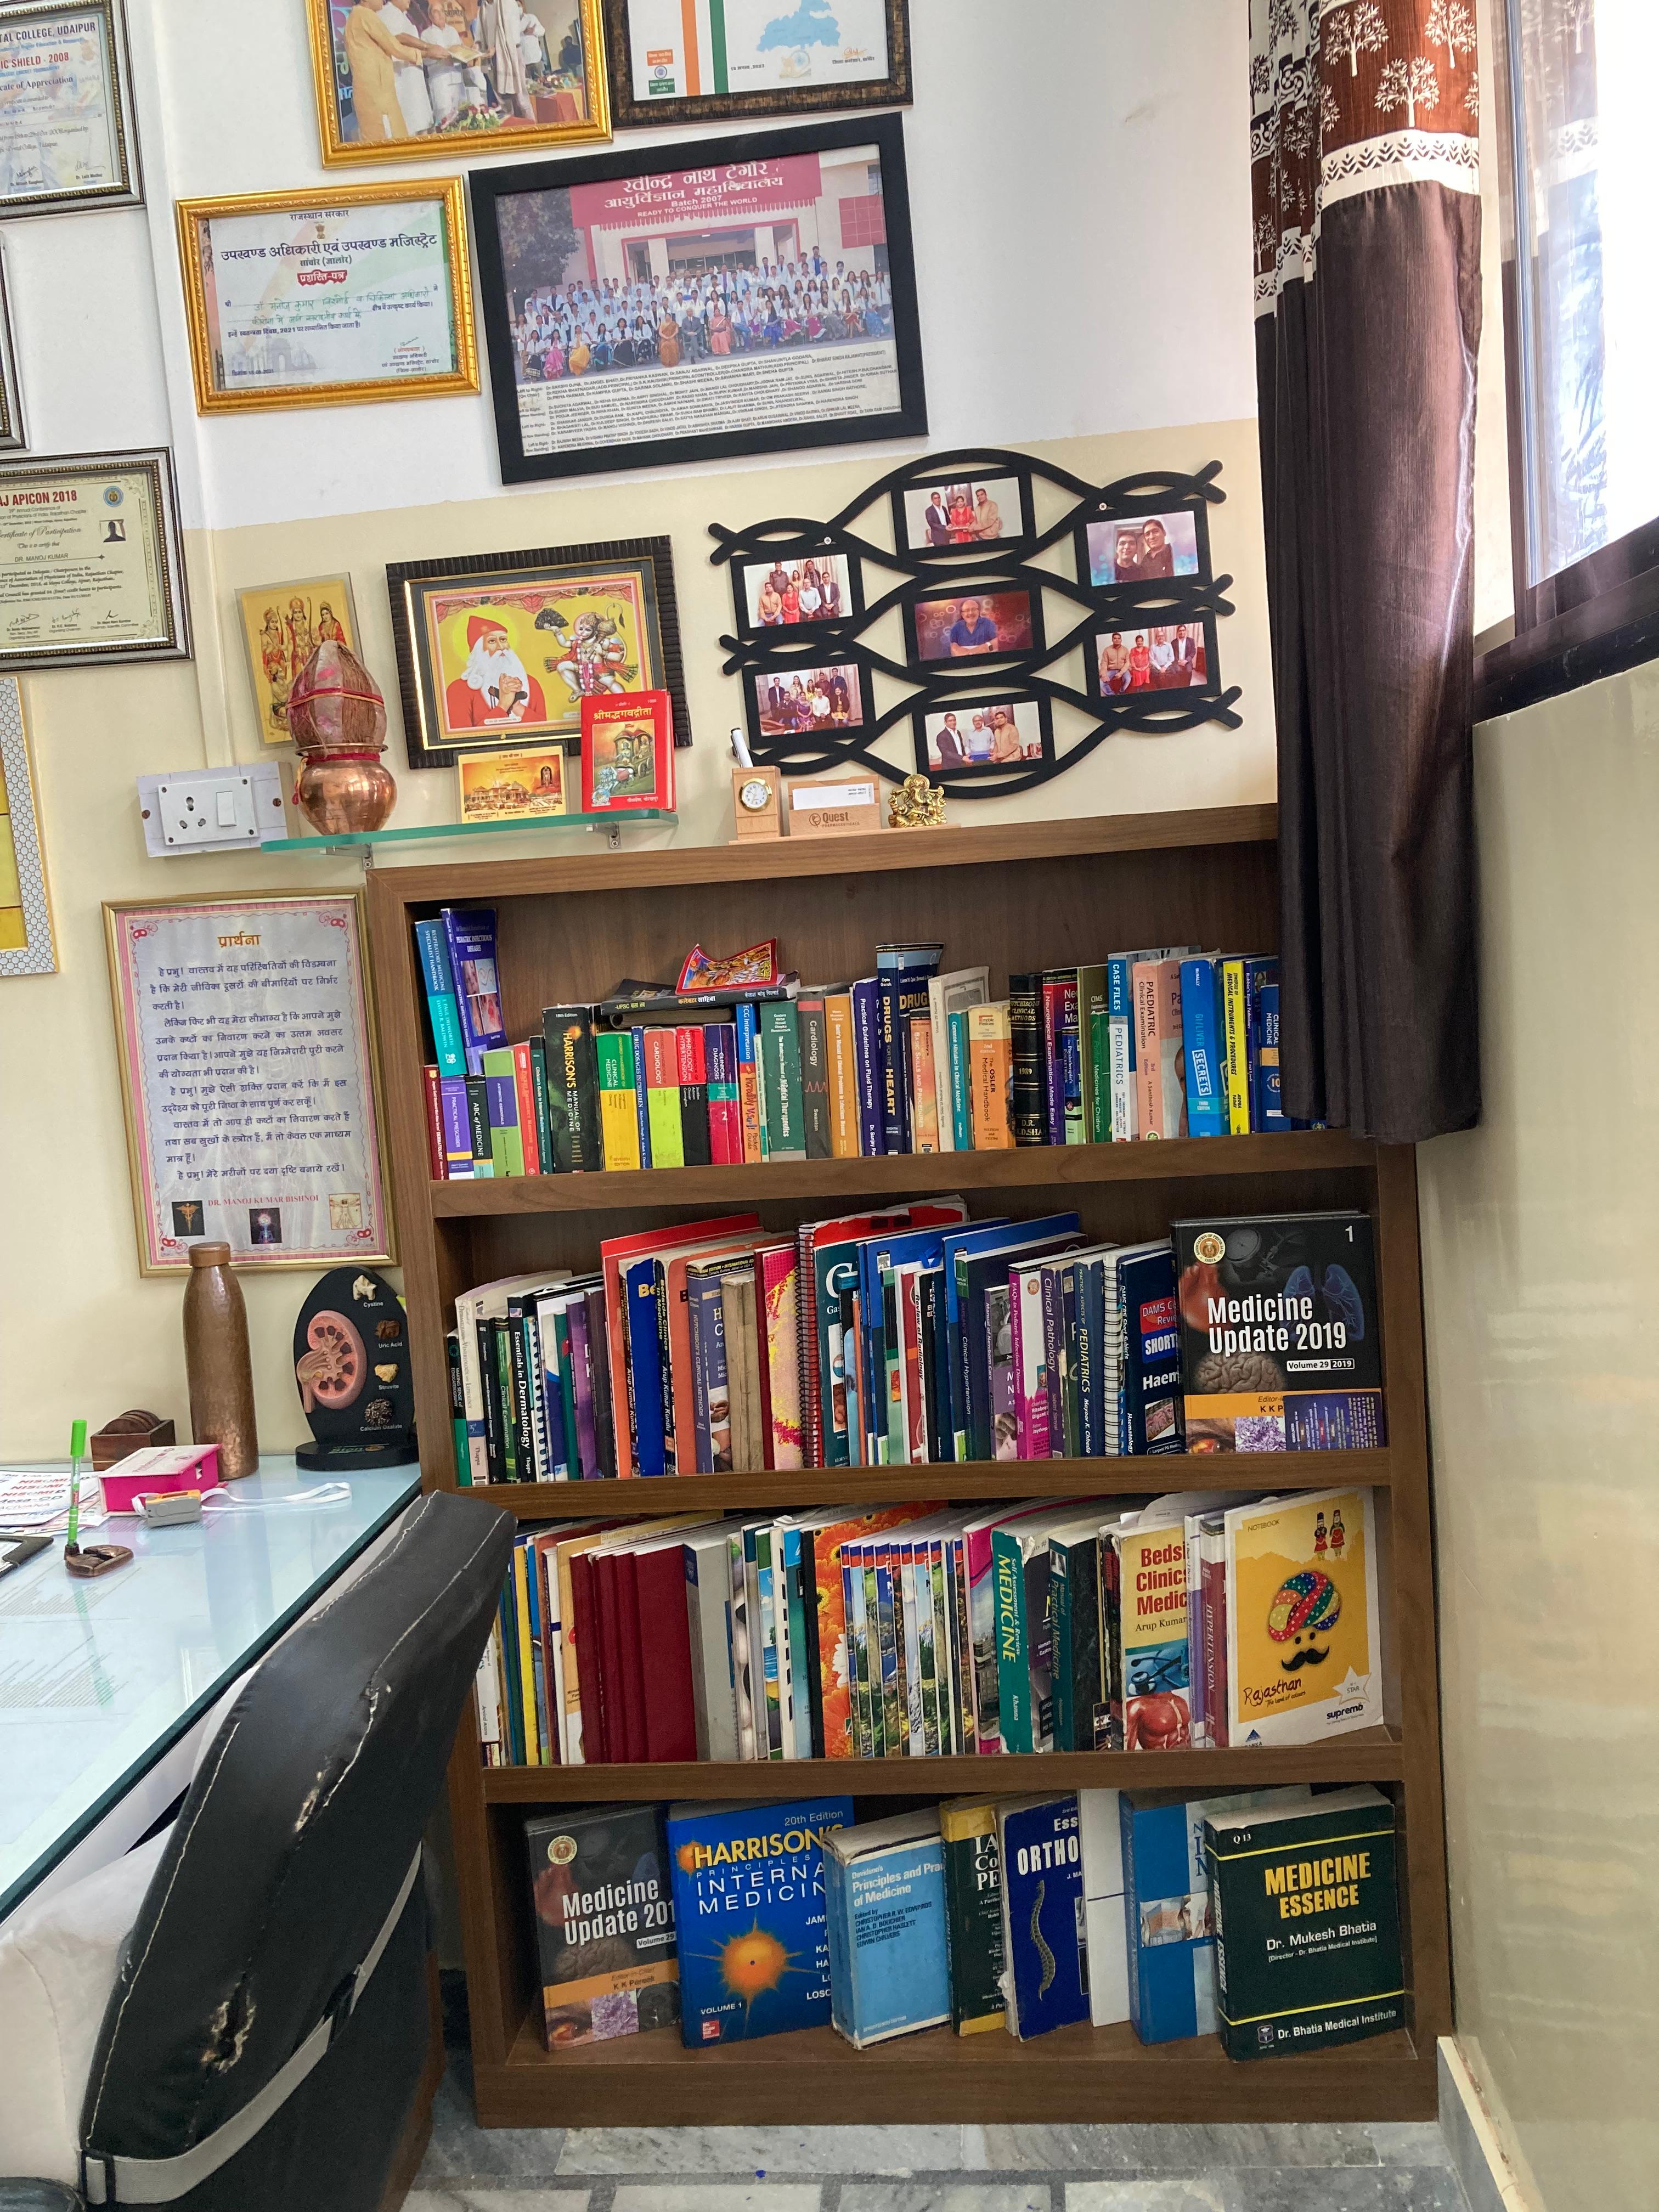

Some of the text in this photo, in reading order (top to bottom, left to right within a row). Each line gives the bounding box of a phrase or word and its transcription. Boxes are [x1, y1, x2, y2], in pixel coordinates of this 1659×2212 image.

[16, 22, 96, 41] COLLEGE, UDAIPUR
[12, 52, 69, 68] SHIELD 2008
[26, 76, 73, 89] Appreciation
[683, 168, 716, 184] नाथ
[671, 195, 722, 207] Batch 2007
[676, 203, 712, 213] CONQUER
[730, 197, 758, 205] WORLD
[289, 210, 349, 222] राजस्थान सरकार
[221, 246, 266, 261] उपखण्ड
[270, 241, 320, 257] अधिकारी
[323, 238, 339, 255] एवं
[341, 238, 387, 252] उपखण्ड
[13, 490, 77, 505] APICON 2018
[823, 811, 849, 822] Quest
[217, 932, 261, 948] प्रार्थना
[431, 930, 441, 963] RESPIRATORY
[189, 965, 214, 974] वास्तव
[227, 964, 238, 972] यह
[289, 960, 299, 968] की
[425, 930, 439, 991] SPECIALIST HANDBOOK
[1146, 981, 1155, 1037] PAEDIATRIC
[810, 1020, 818, 1066] Cardiology
[1195, 1013, 1204, 1046] GI/LIVER
[563, 1032, 576, 1088] HARRISON'S
[653, 1041, 662, 1085] CARDIOLOGY
[883, 996, 895, 1115] DRUGS HEART
[1115, 1028, 1124, 1085] PEDIATRICS
[1195, 1052, 1209, 1093] SECRETS
[866, 1085, 874, 1109] Therapy
[575, 1122, 581, 1132] OF
[254, 1196, 284, 1204] KUMAR
[286, 1194, 318, 1203] BISHNOI
[1345, 1225, 1354, 1242] 1
[1207, 1294, 1313, 1324] Medicine
[1044, 1278, 1056, 1372] Clinical Pathology
[1209, 1322, 1346, 1357] Update 2019
[514, 1331, 525, 1369] Essentials
[1079, 1328, 1090, 1393] PEDIATRICS
[1288, 1361, 1317, 1370] Volume
[1332, 1359, 1352, 1368] 2019
[518, 1380, 531, 1449] Dermatology
[1248, 1519, 1280, 1532] NOTEBOOK
[998, 1554, 1016, 1663] MEDICINE
[1051, 1579, 1060, 1679] Practical Medicine
[1135, 1616, 1187, 1632] Arup Kumar
[1206, 1603, 1216, 1692] HYPERTENSION
[1243, 1678, 1302, 1707] Rajasthan
[1347, 1685, 1359, 1694] STAR
[1327, 1702, 1364, 1719] supremo
[785, 1810, 843, 1826] 20th Edition
[696, 1854, 811, 1878] PRINCIPLES
[1018, 1836, 1079, 1876] ORTHO
[853, 1865, 922, 1893] Principles and
[1265, 1852, 1372, 1896] MEDICINE
[562, 1880, 658, 1918] Medicine
[854, 1884, 912, 1907] of Medicine
[1279, 1884, 1359, 1919] ESSENCE
[565, 1909, 638, 1946] Update
[1267, 1921, 1377, 1951] Dr. Mukesh Bhatia
[701, 2004, 736, 2015] VOLUME
[1278, 2008, 1397, 2039] Dr. Bhatia Medical Institute
